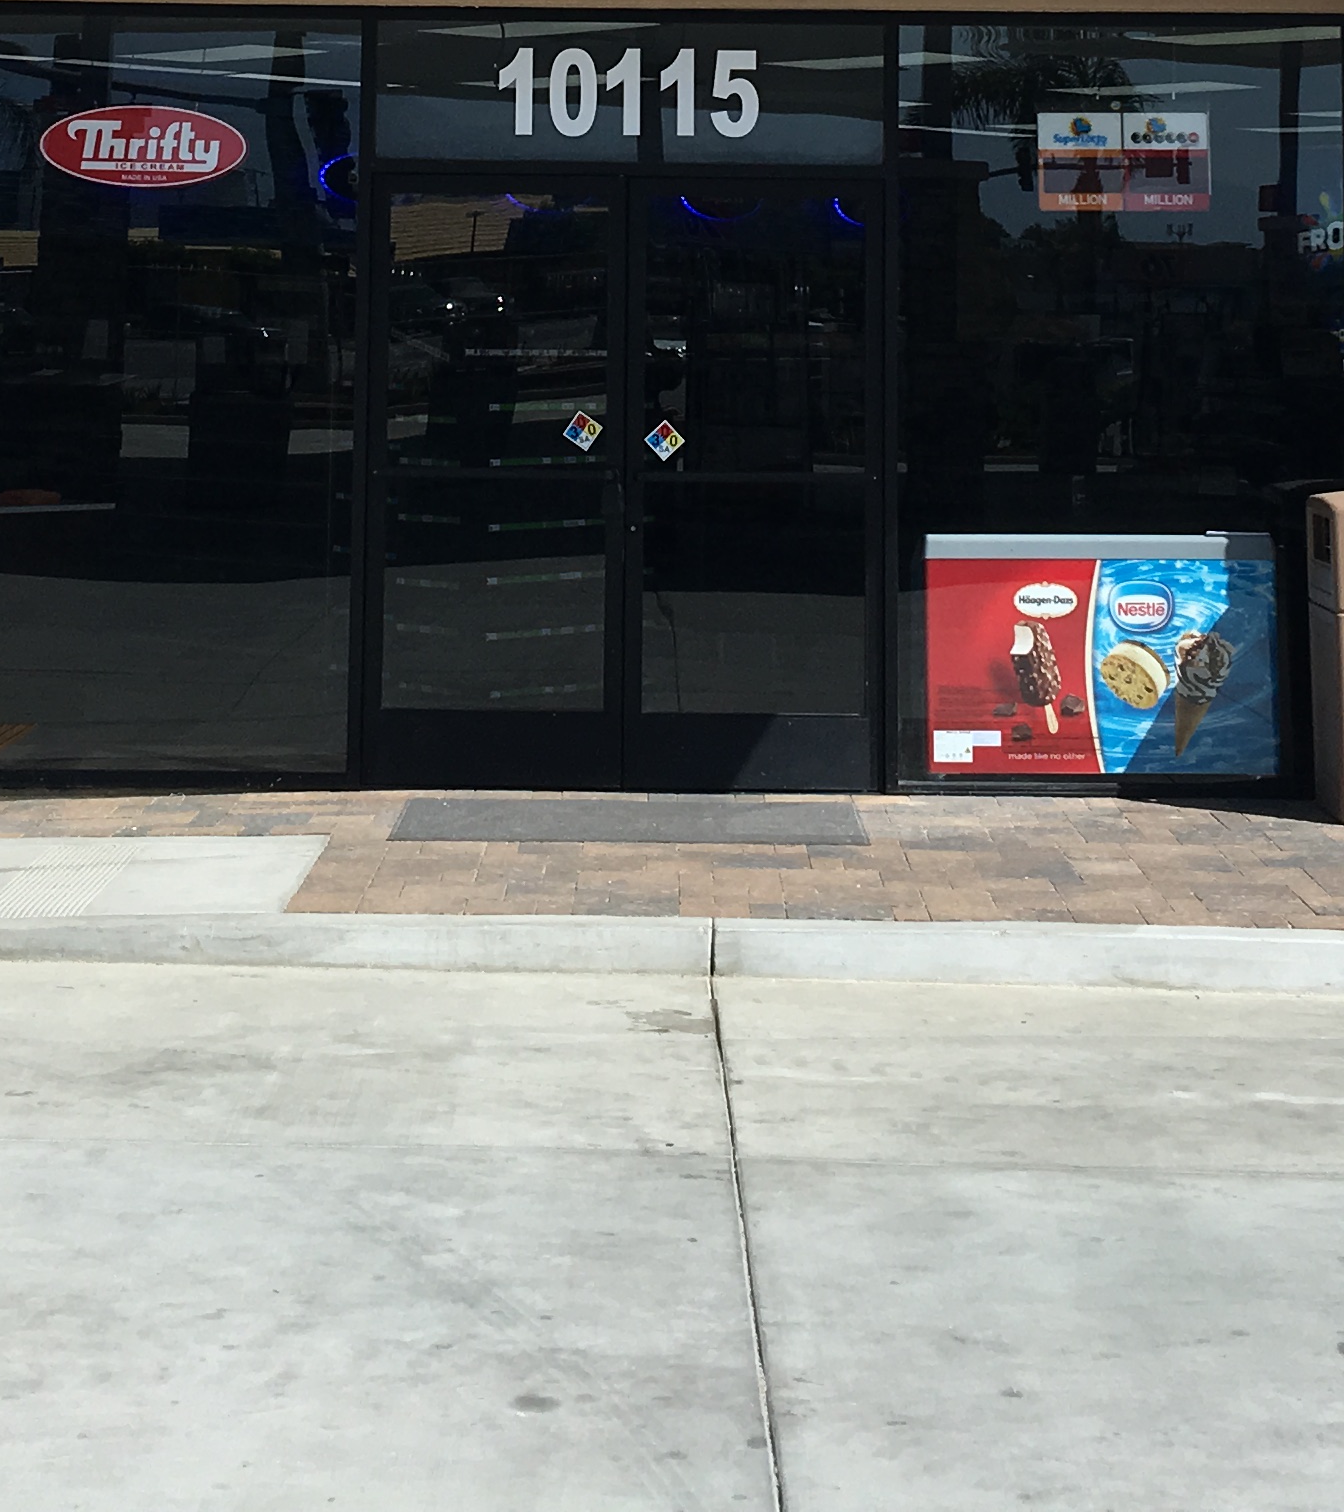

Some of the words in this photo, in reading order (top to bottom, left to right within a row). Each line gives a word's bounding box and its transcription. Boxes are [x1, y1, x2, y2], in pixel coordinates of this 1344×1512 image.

[497, 46, 761, 139] 10115
[67, 119, 221, 172] Thrifty
[115, 162, 136, 170] ICE
[140, 162, 186, 171] CREAM
[1058, 194, 1108, 206] MILLION
[1144, 194, 1194, 206] MILLION
[587, 424, 596, 435] 0
[669, 435, 678, 447] 0
[1008, 752, 1033, 760] made
